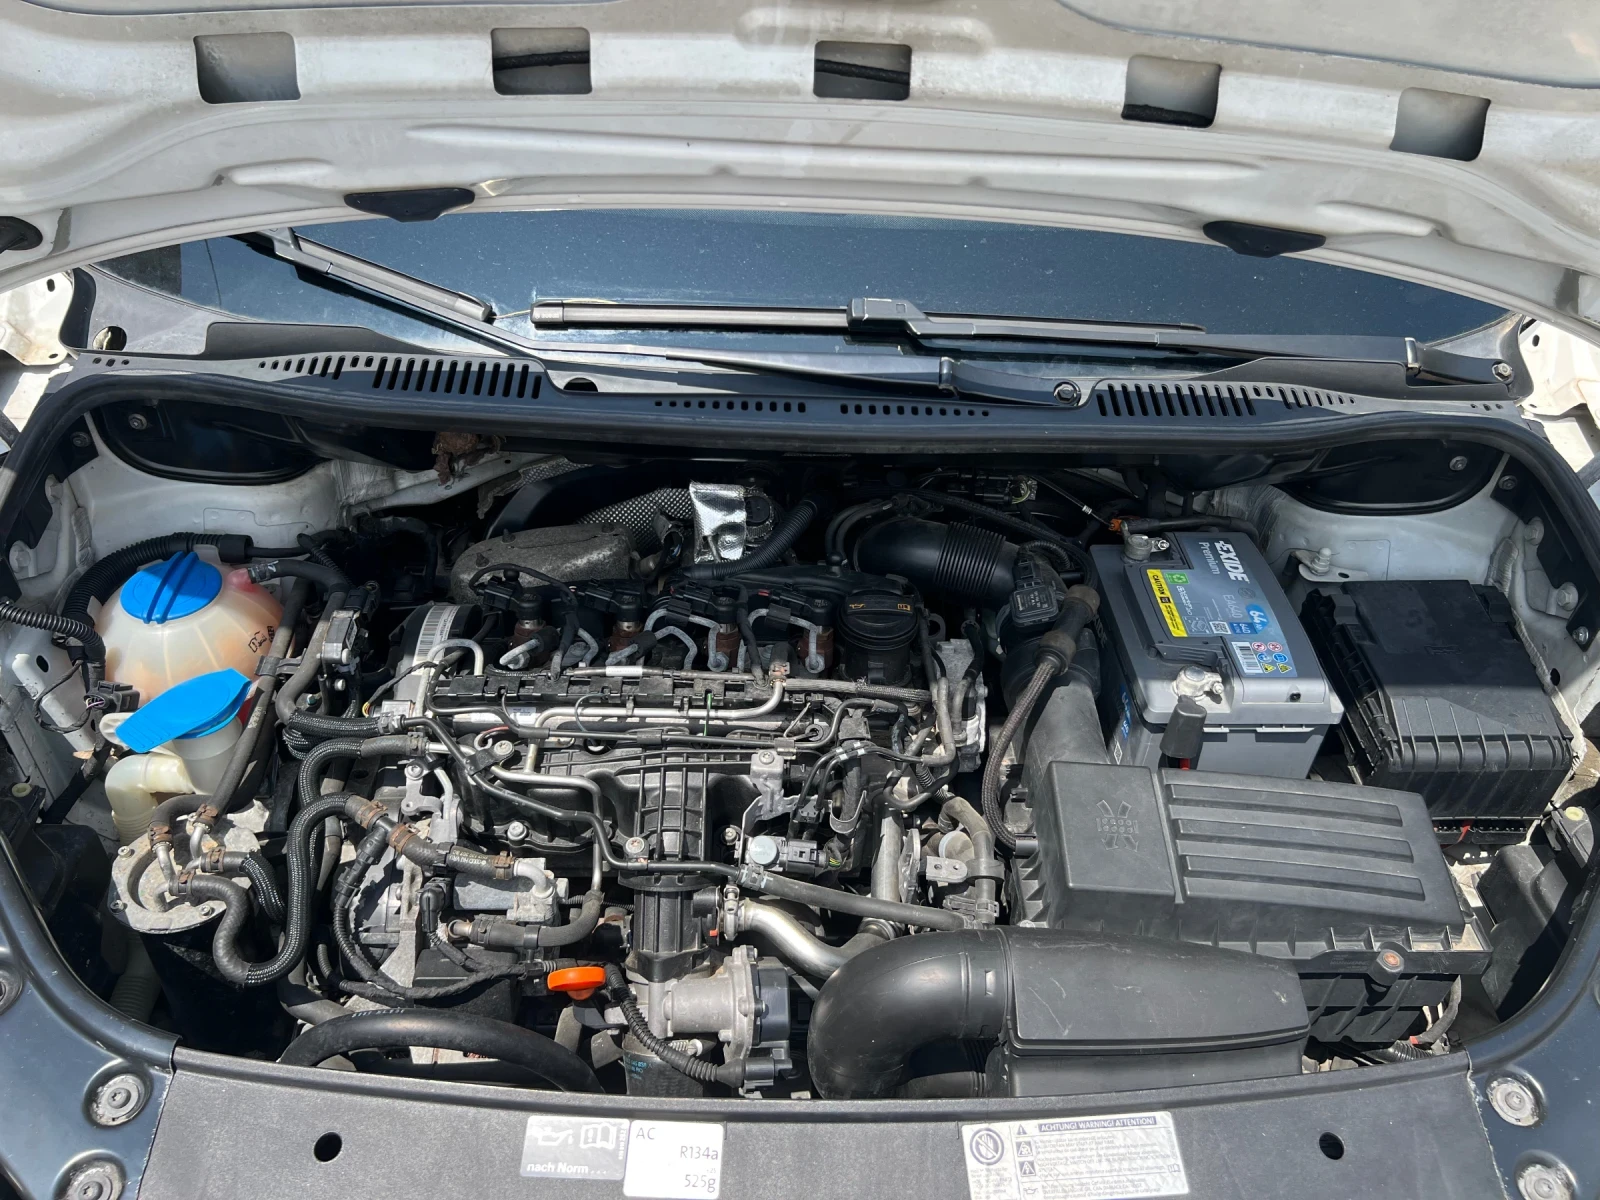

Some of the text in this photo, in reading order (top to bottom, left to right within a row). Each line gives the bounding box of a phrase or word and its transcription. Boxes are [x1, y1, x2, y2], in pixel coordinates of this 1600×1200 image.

[1199, 542, 1220, 574] Premium
[1214, 541, 1249, 582] EXIDE
[1152, 575, 1165, 595] CAUTION
[1223, 594, 1243, 619] EA640
[1249, 610, 1268, 624] 64
[1040, 1116, 1156, 1132] ACHTUNG! WARNING! ATTENTION!
[636, 1127, 656, 1140] AC
[680, 1146, 719, 1160] R134a
[527, 1162, 555, 1173] nach
[684, 1174, 716, 1193] 525g
